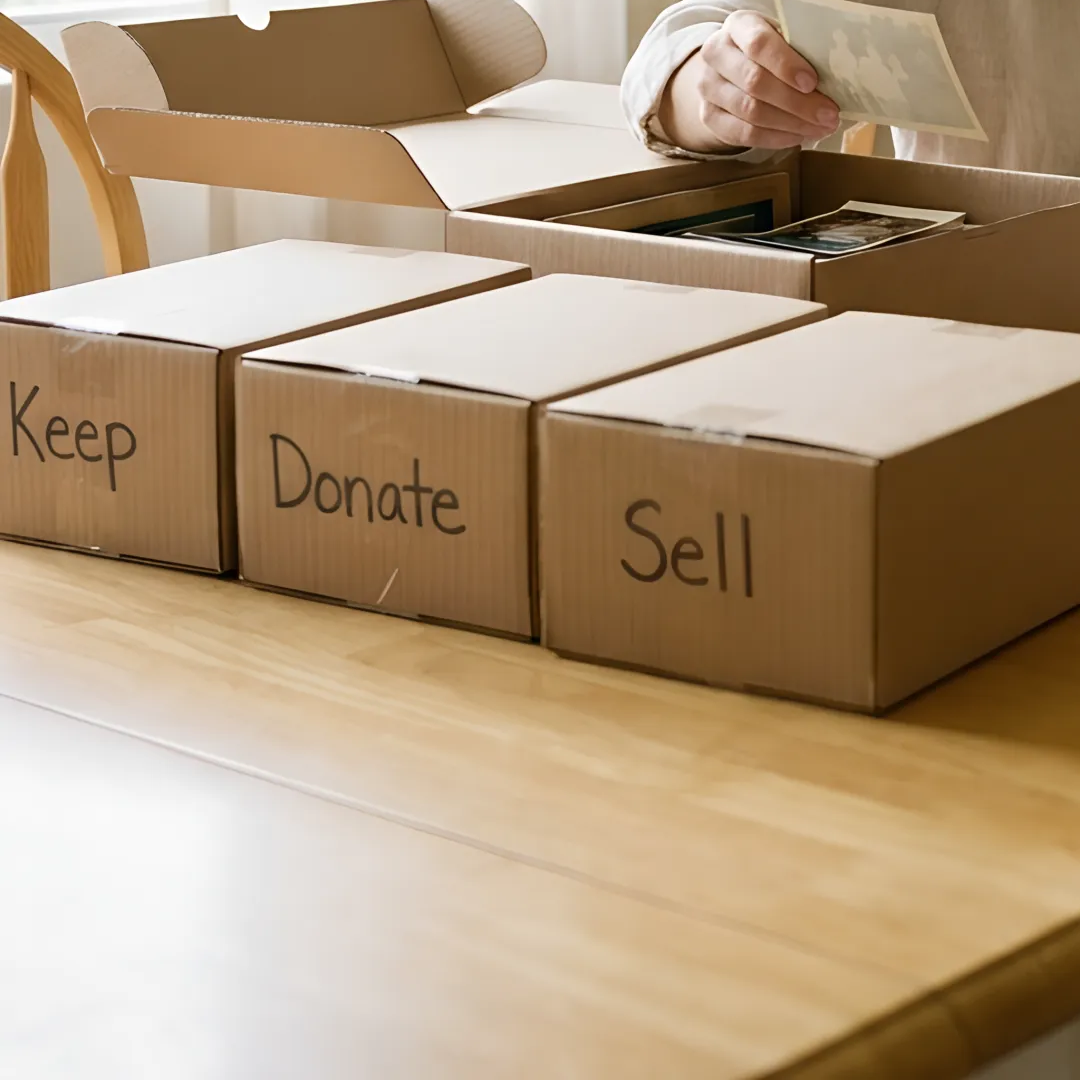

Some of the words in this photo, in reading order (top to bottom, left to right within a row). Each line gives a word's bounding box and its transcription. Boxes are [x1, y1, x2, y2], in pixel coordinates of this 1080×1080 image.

[9, 380, 137, 492] Keep
[269, 433, 467, 535] Donate
[619, 498, 754, 598] Sell
